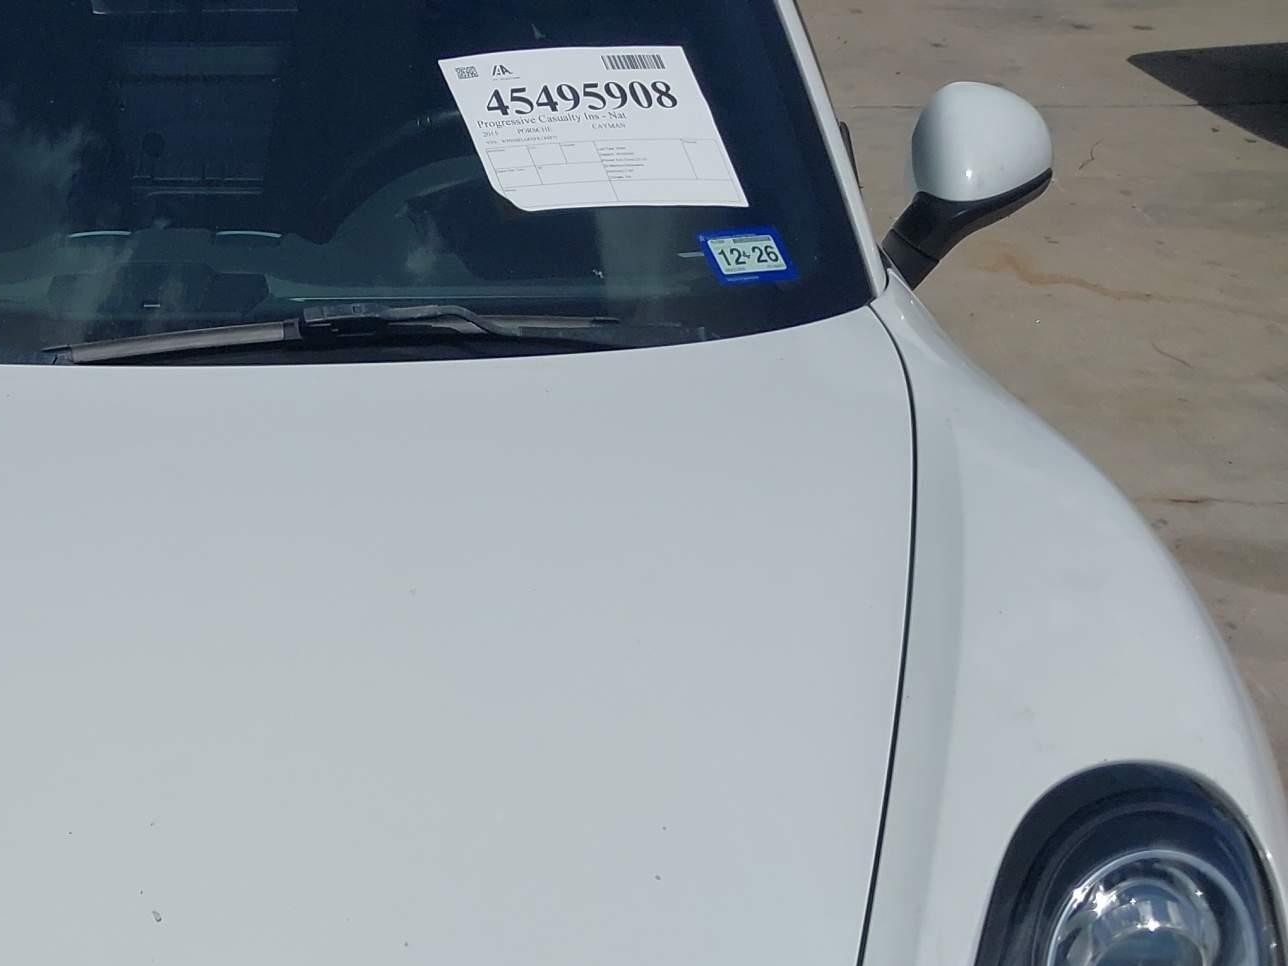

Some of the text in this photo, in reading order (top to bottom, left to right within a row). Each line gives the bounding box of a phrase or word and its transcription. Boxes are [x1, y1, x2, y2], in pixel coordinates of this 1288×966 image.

[486, 81, 678, 116] 45495908
[477, 116, 536, 129] Progressive
[538, 112, 581, 124] Casualty
[584, 112, 600, 120] Ins
[608, 111, 626, 120] Nat
